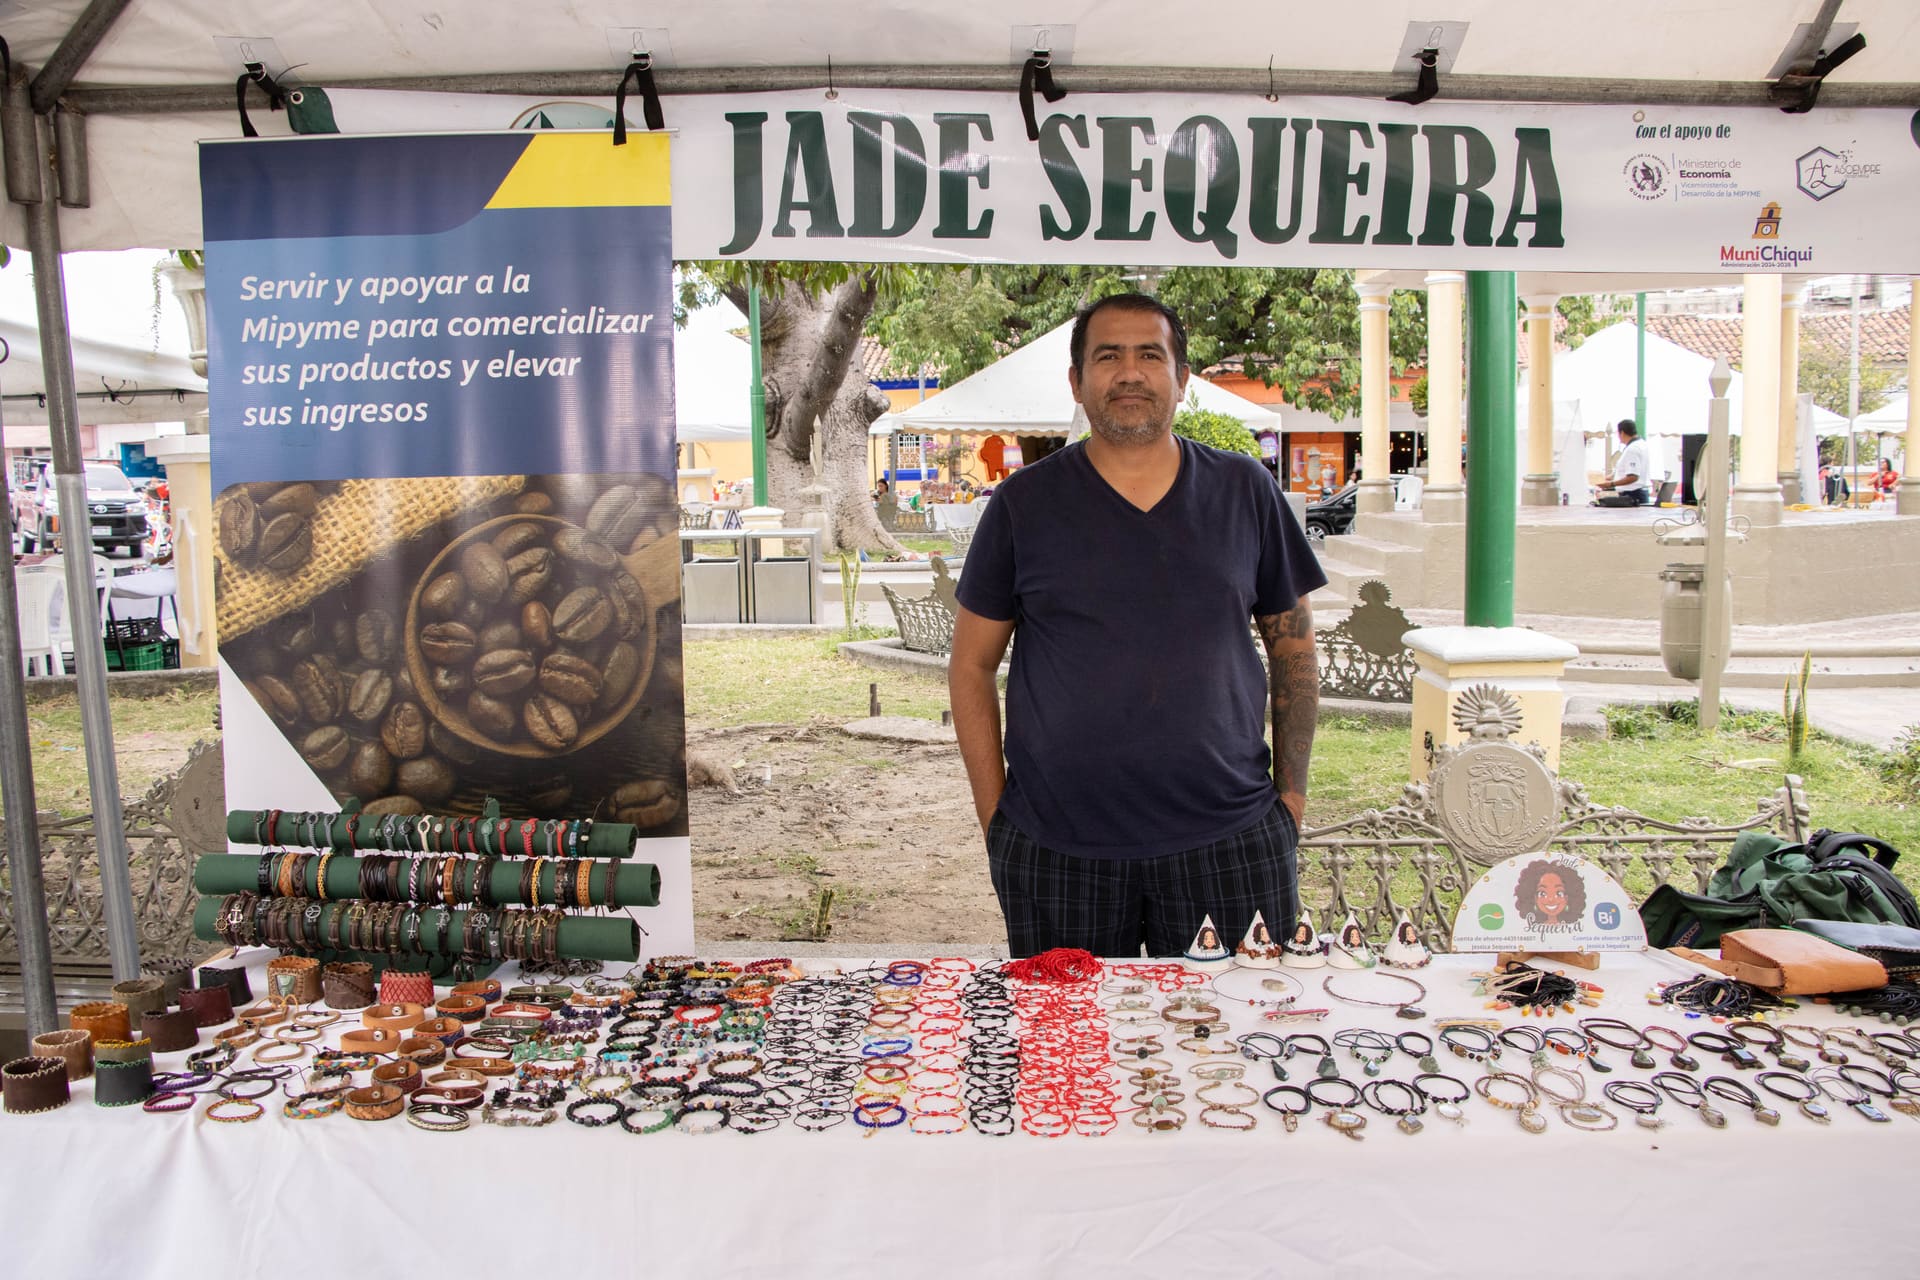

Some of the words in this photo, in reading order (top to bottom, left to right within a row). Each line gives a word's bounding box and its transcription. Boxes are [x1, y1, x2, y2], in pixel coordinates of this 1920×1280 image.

[1635, 124, 1657, 139] Con
[1659, 124, 1671, 139] el
[1674, 124, 1712, 141] apoyo
[1716, 123, 1731, 139] de
[1678, 159, 1727, 169] Ministerio
[1728, 159, 1742, 169] de
[1679, 169, 1731, 179] Economía
[718, 111, 995, 256] JADE
[1038, 113, 1566, 261] SEQUEIRA
[1628, 187, 1668, 201] GUATEMALA
[1720, 245, 1813, 267] MuniChiqui
[240, 272, 329, 301] Servir
[334, 276, 353, 305] y
[360, 272, 468, 304] apoyar
[475, 274, 494, 294] a
[503, 265, 531, 294] la
[241, 315, 360, 349] Mipyme
[367, 314, 438, 346] para
[447, 306, 654, 336] comercializar
[242, 361, 290, 385] sus
[299, 353, 452, 390] productos
[459, 357, 479, 386] y
[487, 350, 581, 378] elevar
[243, 401, 292, 426] sus
[301, 398, 428, 432] ingresos
[1524, 911, 1584, 942] Sequeira
[1598, 908, 1617, 925] Bi
